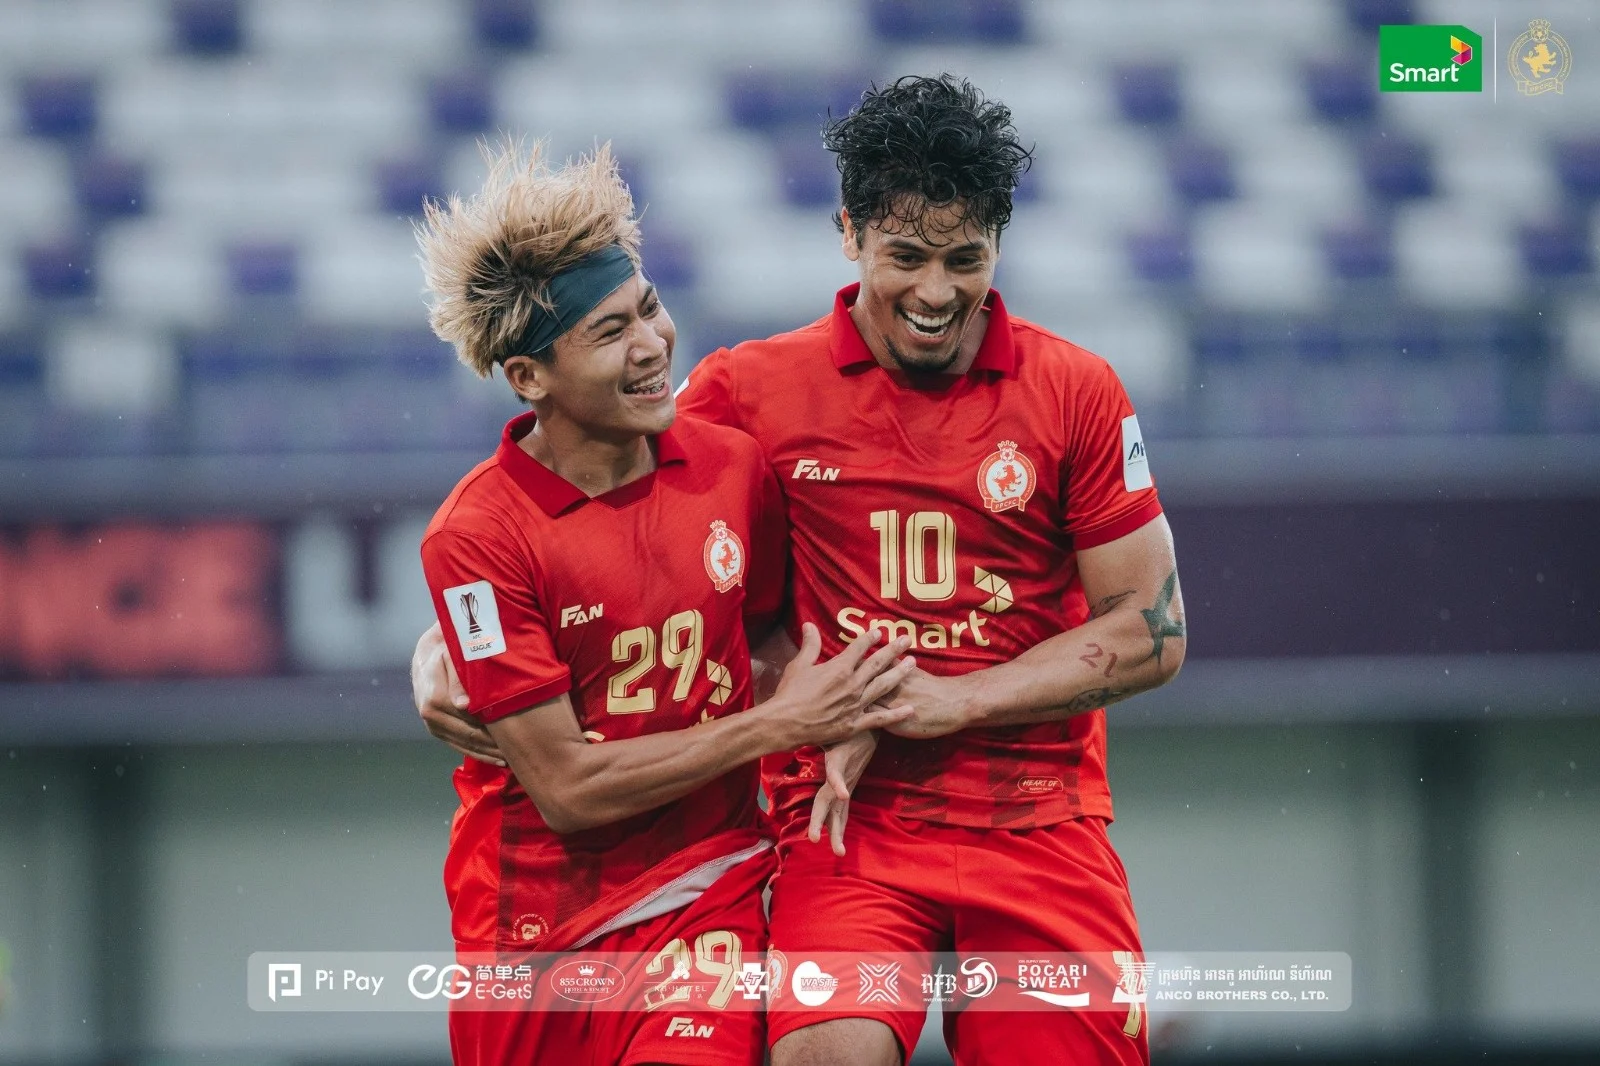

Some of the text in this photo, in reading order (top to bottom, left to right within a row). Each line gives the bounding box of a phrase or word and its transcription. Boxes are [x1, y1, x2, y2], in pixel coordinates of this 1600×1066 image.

[791, 459, 840, 482] FAN
[870, 509, 957, 601] 10
[560, 602, 604, 628] FAN
[836, 606, 990, 650] Smart
[607, 609, 703, 715] 29
[1022, 779, 1048, 787] HEART
[644, 930, 743, 1013] 29
[664, 1016, 715, 1039] FAN
